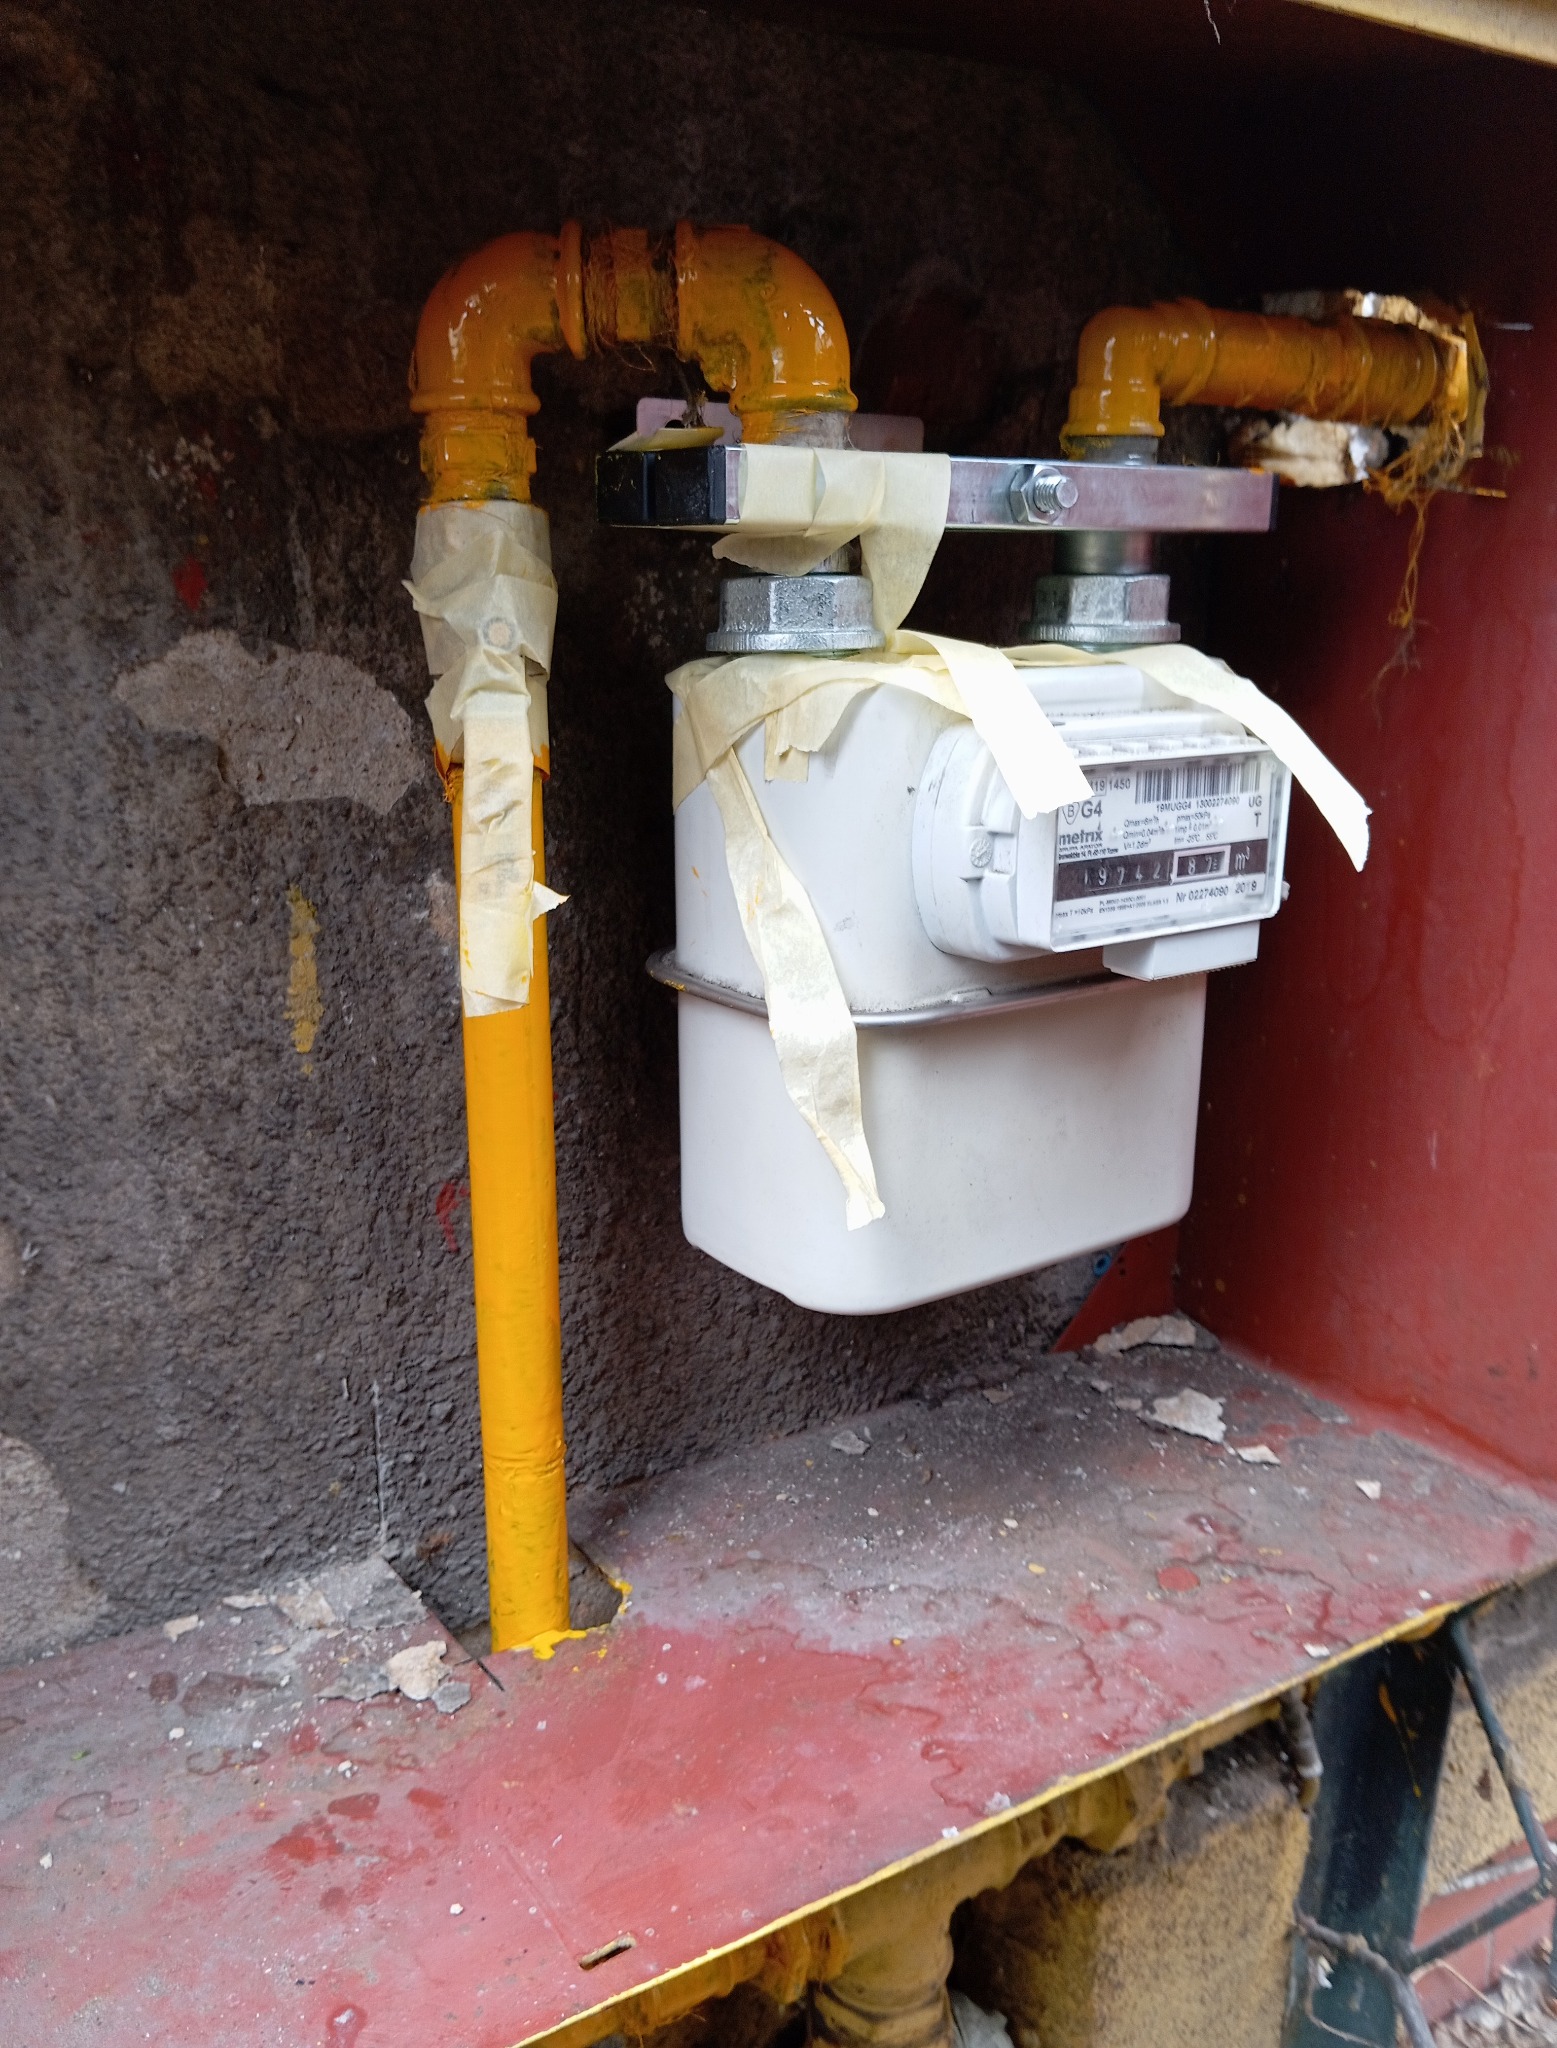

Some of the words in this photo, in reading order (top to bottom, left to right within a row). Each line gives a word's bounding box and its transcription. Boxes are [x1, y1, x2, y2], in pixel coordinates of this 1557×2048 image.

[1108, 778, 1131, 791] 1450
[1081, 800, 1103, 819] G4
[1248, 795, 1262, 808] UG
[1254, 812, 1262, 827] T
[1058, 825, 1103, 846] metrix
[1176, 891, 1187, 903] Nr
[1188, 886, 1229, 901] 02274090
